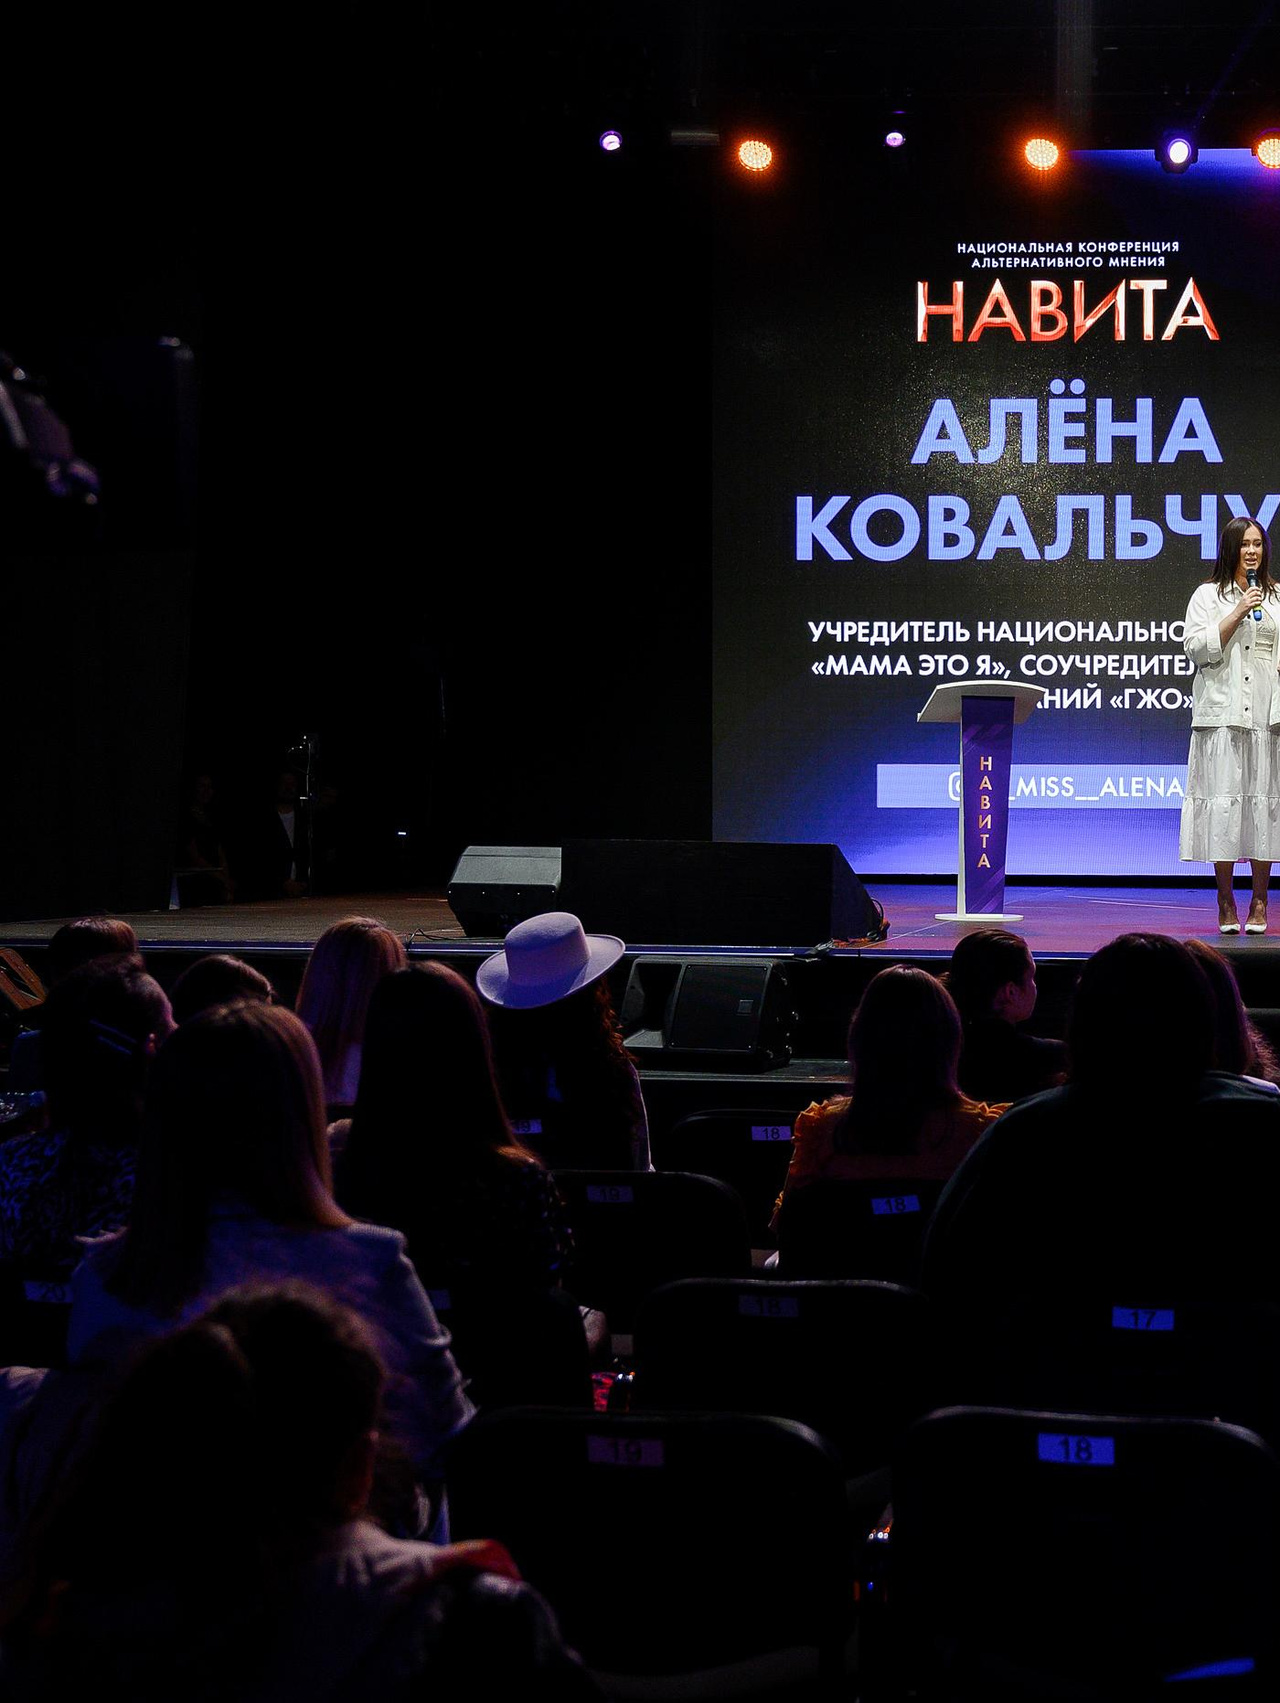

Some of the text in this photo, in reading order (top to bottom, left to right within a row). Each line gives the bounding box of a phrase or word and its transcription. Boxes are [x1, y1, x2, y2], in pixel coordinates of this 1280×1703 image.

[957, 241, 1180, 255] НАЦИОНАЛЬНАЯ КОНФЕРЕНЦИЯ
[971, 256, 1165, 268] АЛЬТЕРНАТИВНОГО МНЕНИЯ
[917, 277, 1220, 343] НАВИТА
[910, 378, 1224, 464] АЛЁНА
[808, 621, 1186, 646] УЧРЕДИТЕЛЬ НАЦИОНАЛЬНО
[811, 654, 1195, 680] «МАМА ЭТО Я», СОУЧРЕДИТЕ
[977, 756, 993, 868] НАВИТА
[763, 1127, 780, 1139] 18
[602, 1188, 620, 1201] 19
[885, 1197, 906, 1212] 18
[1131, 1310, 1157, 1327] 17
[613, 1440, 642, 1464] 19
[1059, 1436, 1093, 1461] 18
